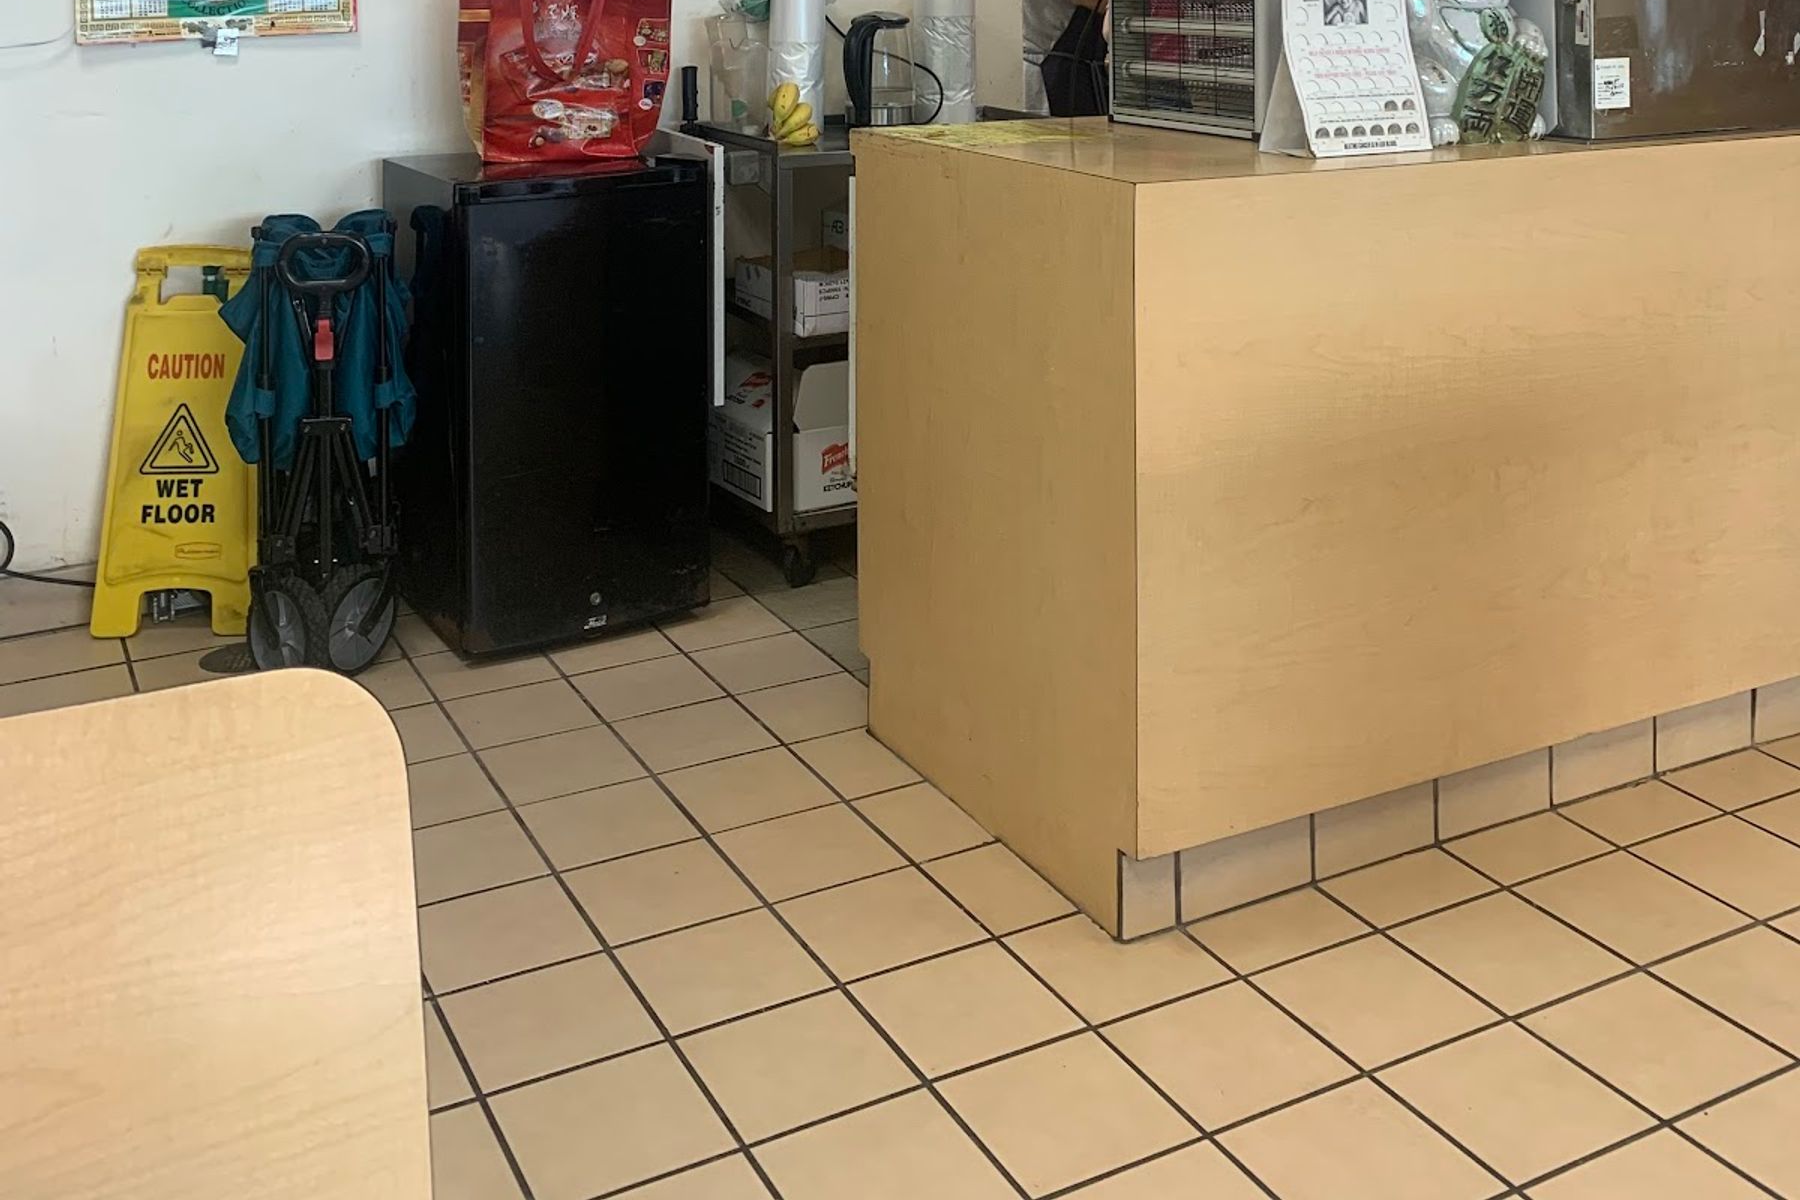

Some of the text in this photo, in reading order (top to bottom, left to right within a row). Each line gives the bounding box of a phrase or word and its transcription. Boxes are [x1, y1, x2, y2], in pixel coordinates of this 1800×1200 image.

[148, 353, 225, 379] CAUTION
[156, 479, 203, 498] WET
[141, 504, 215, 524] FLOOR
